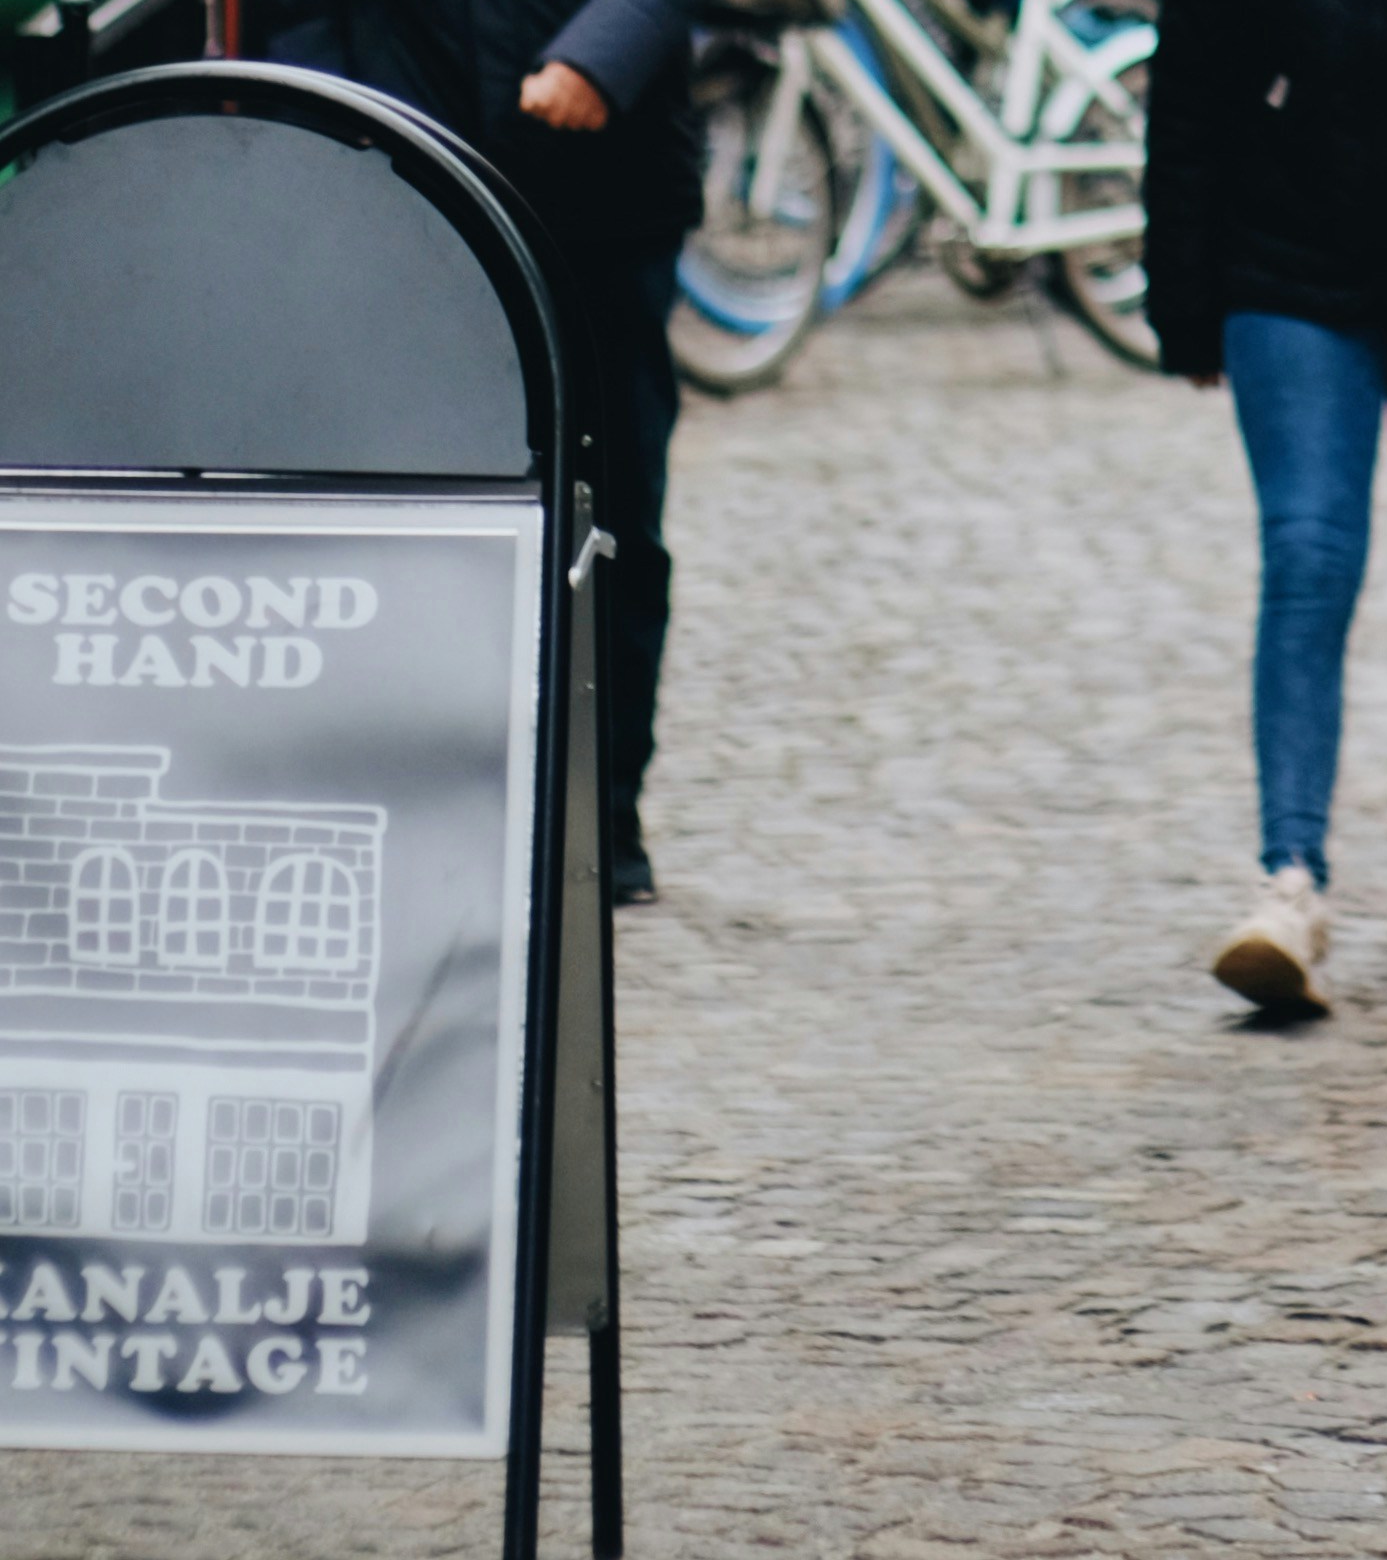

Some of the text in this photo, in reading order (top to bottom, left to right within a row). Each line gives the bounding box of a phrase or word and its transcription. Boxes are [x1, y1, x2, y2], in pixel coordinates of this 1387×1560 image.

[7, 572, 379, 629] SECOND
[51, 632, 324, 688] HAND
[0, 1262, 371, 1326] ANALJE
[0, 1332, 368, 1395] INTAGE
